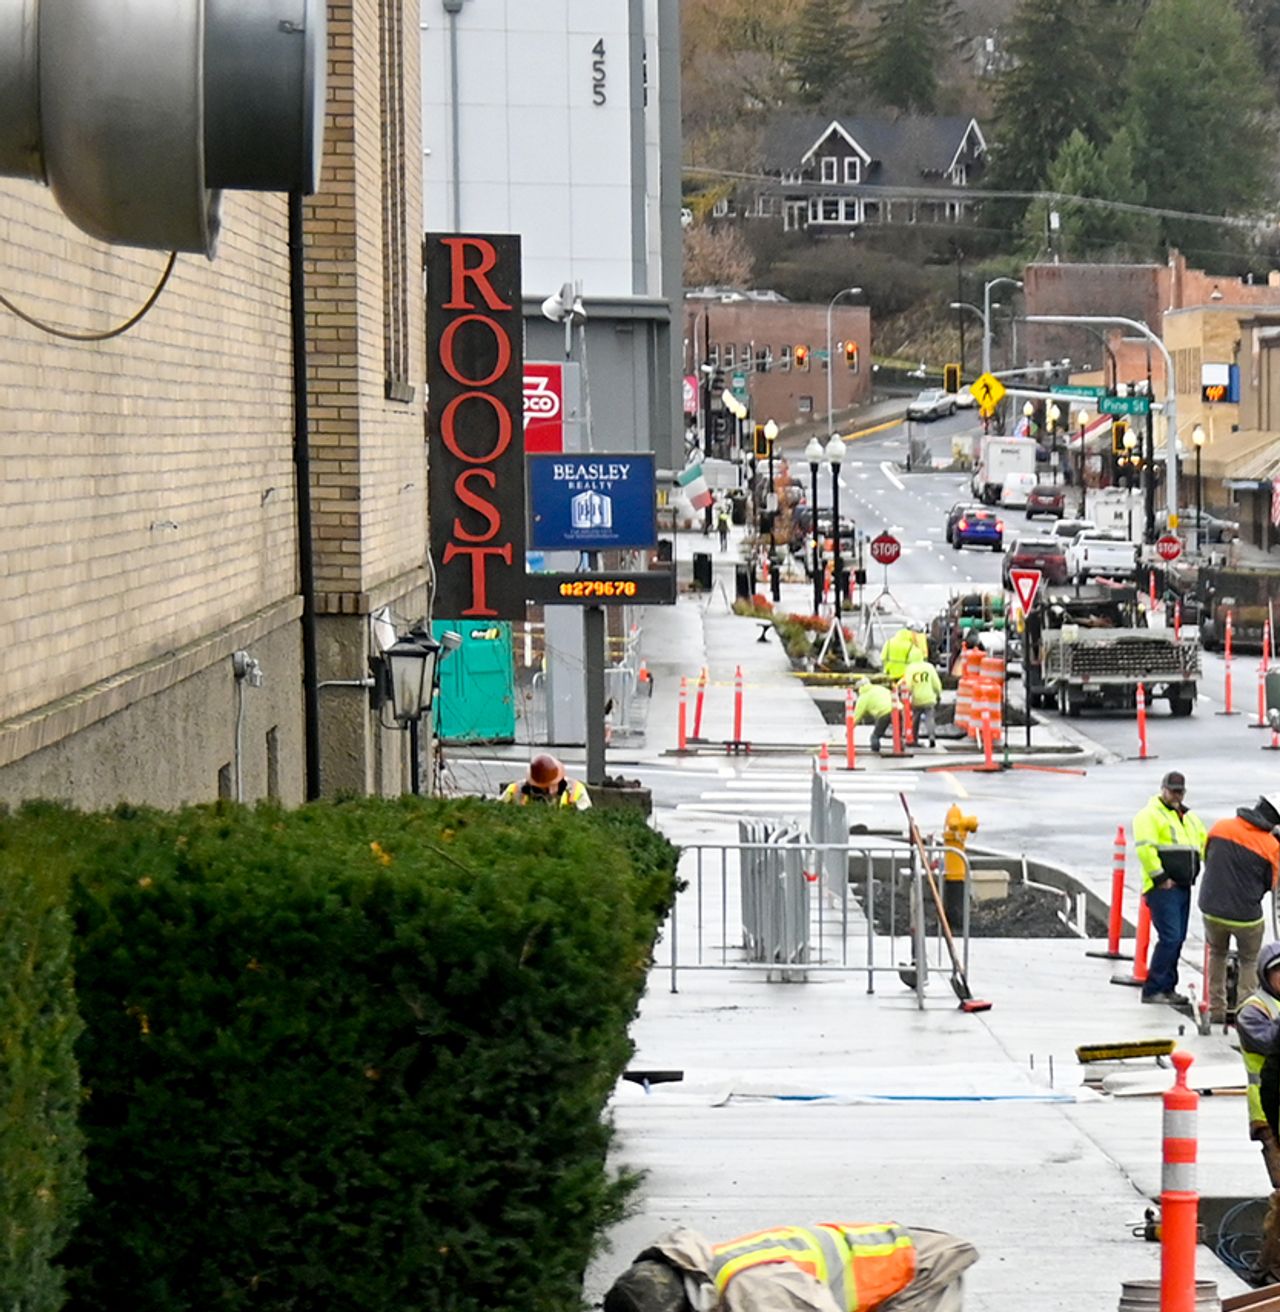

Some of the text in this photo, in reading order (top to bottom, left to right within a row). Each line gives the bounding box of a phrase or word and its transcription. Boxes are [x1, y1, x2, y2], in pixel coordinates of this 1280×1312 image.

[591, 37, 606, 106] 455
[1103, 400, 1144, 411] Pine St
[438, 237, 513, 616] ROOST
[553, 464, 630, 480] BEASLEY
[872, 542, 899, 556] STOP
